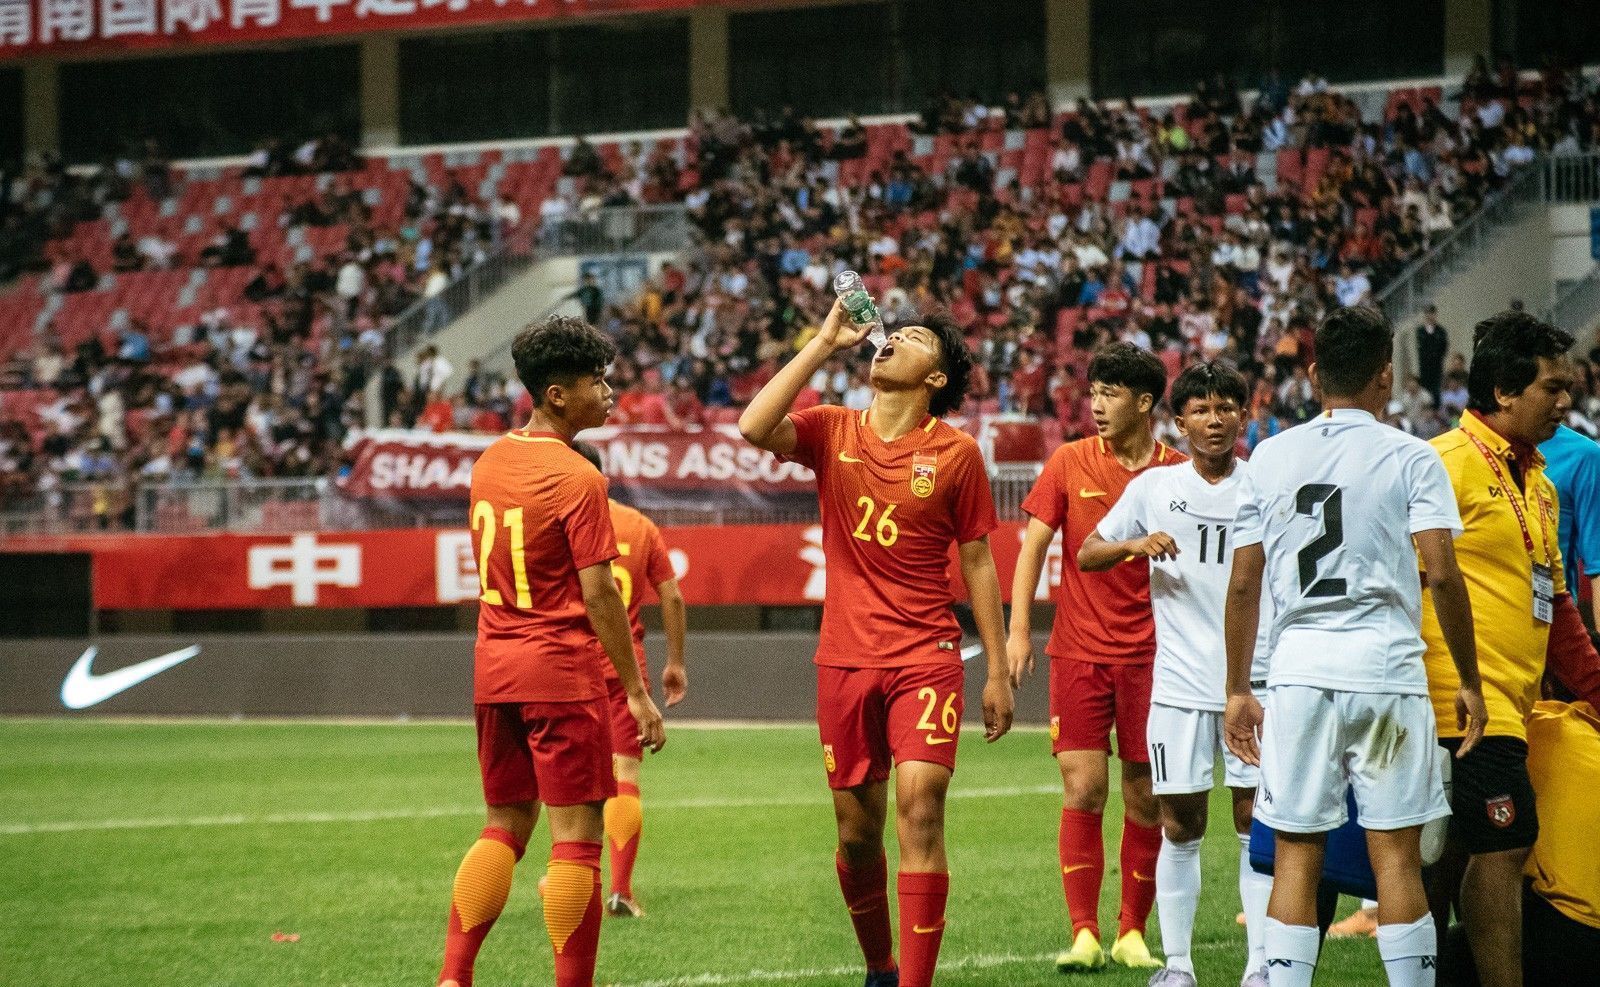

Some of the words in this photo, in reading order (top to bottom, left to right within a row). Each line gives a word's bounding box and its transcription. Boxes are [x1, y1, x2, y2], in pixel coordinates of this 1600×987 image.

[370, 453, 473, 489] SHAA
[599, 441, 669, 478] NS
[852, 496, 898, 547] 26
[1197, 524, 1226, 564] 11
[1296, 483, 1347, 598] 2
[472, 500, 532, 608] 21
[916, 687, 957, 734] 26
[1152, 743, 1167, 782] 11
